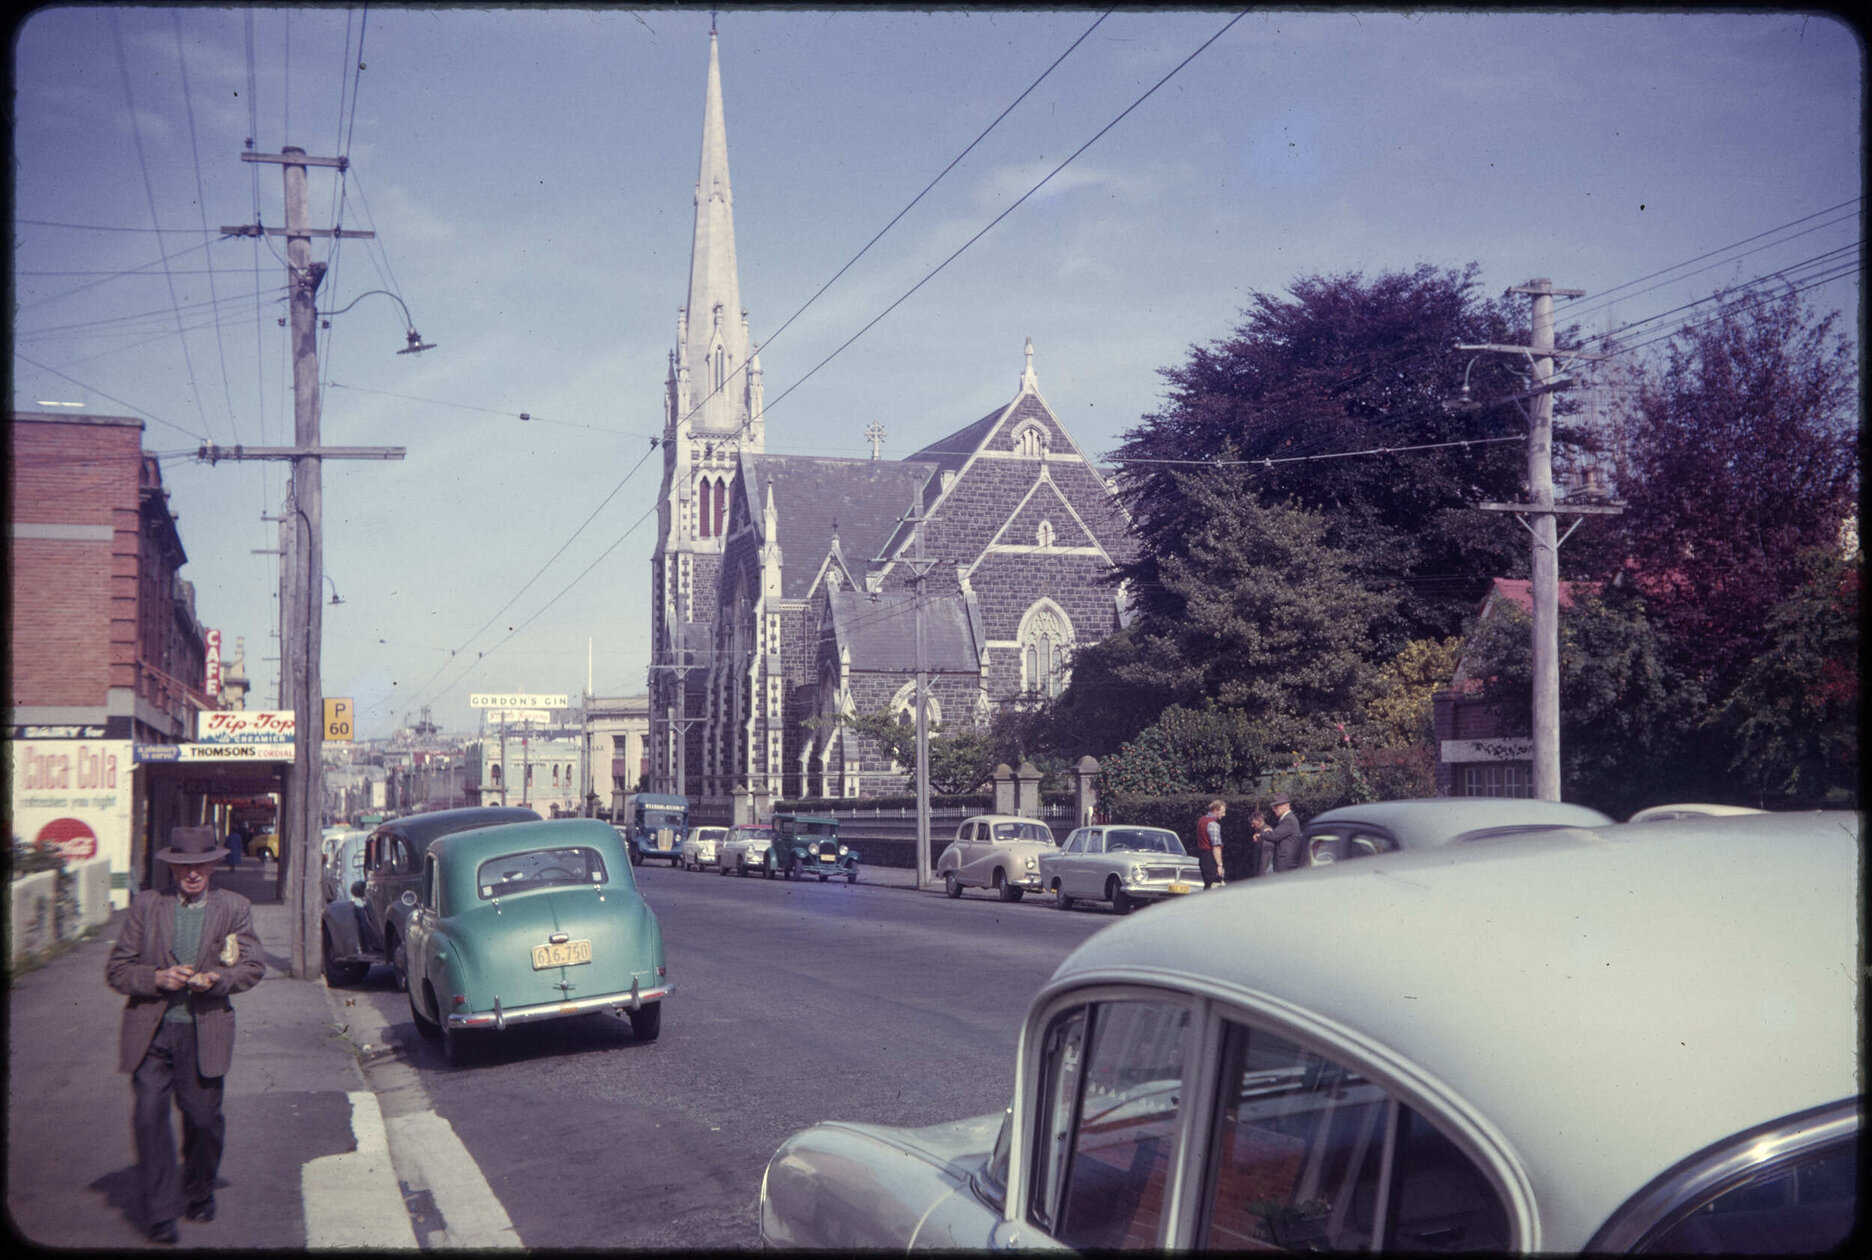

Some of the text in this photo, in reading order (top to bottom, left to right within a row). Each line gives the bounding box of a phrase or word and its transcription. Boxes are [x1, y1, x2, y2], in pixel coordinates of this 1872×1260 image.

[206, 630, 219, 696] CAFE
[472, 697, 567, 705] GORDON'S GIN
[335, 702, 346, 718] P
[329, 721, 349, 735] 60
[190, 747, 256, 757] THOMSONS
